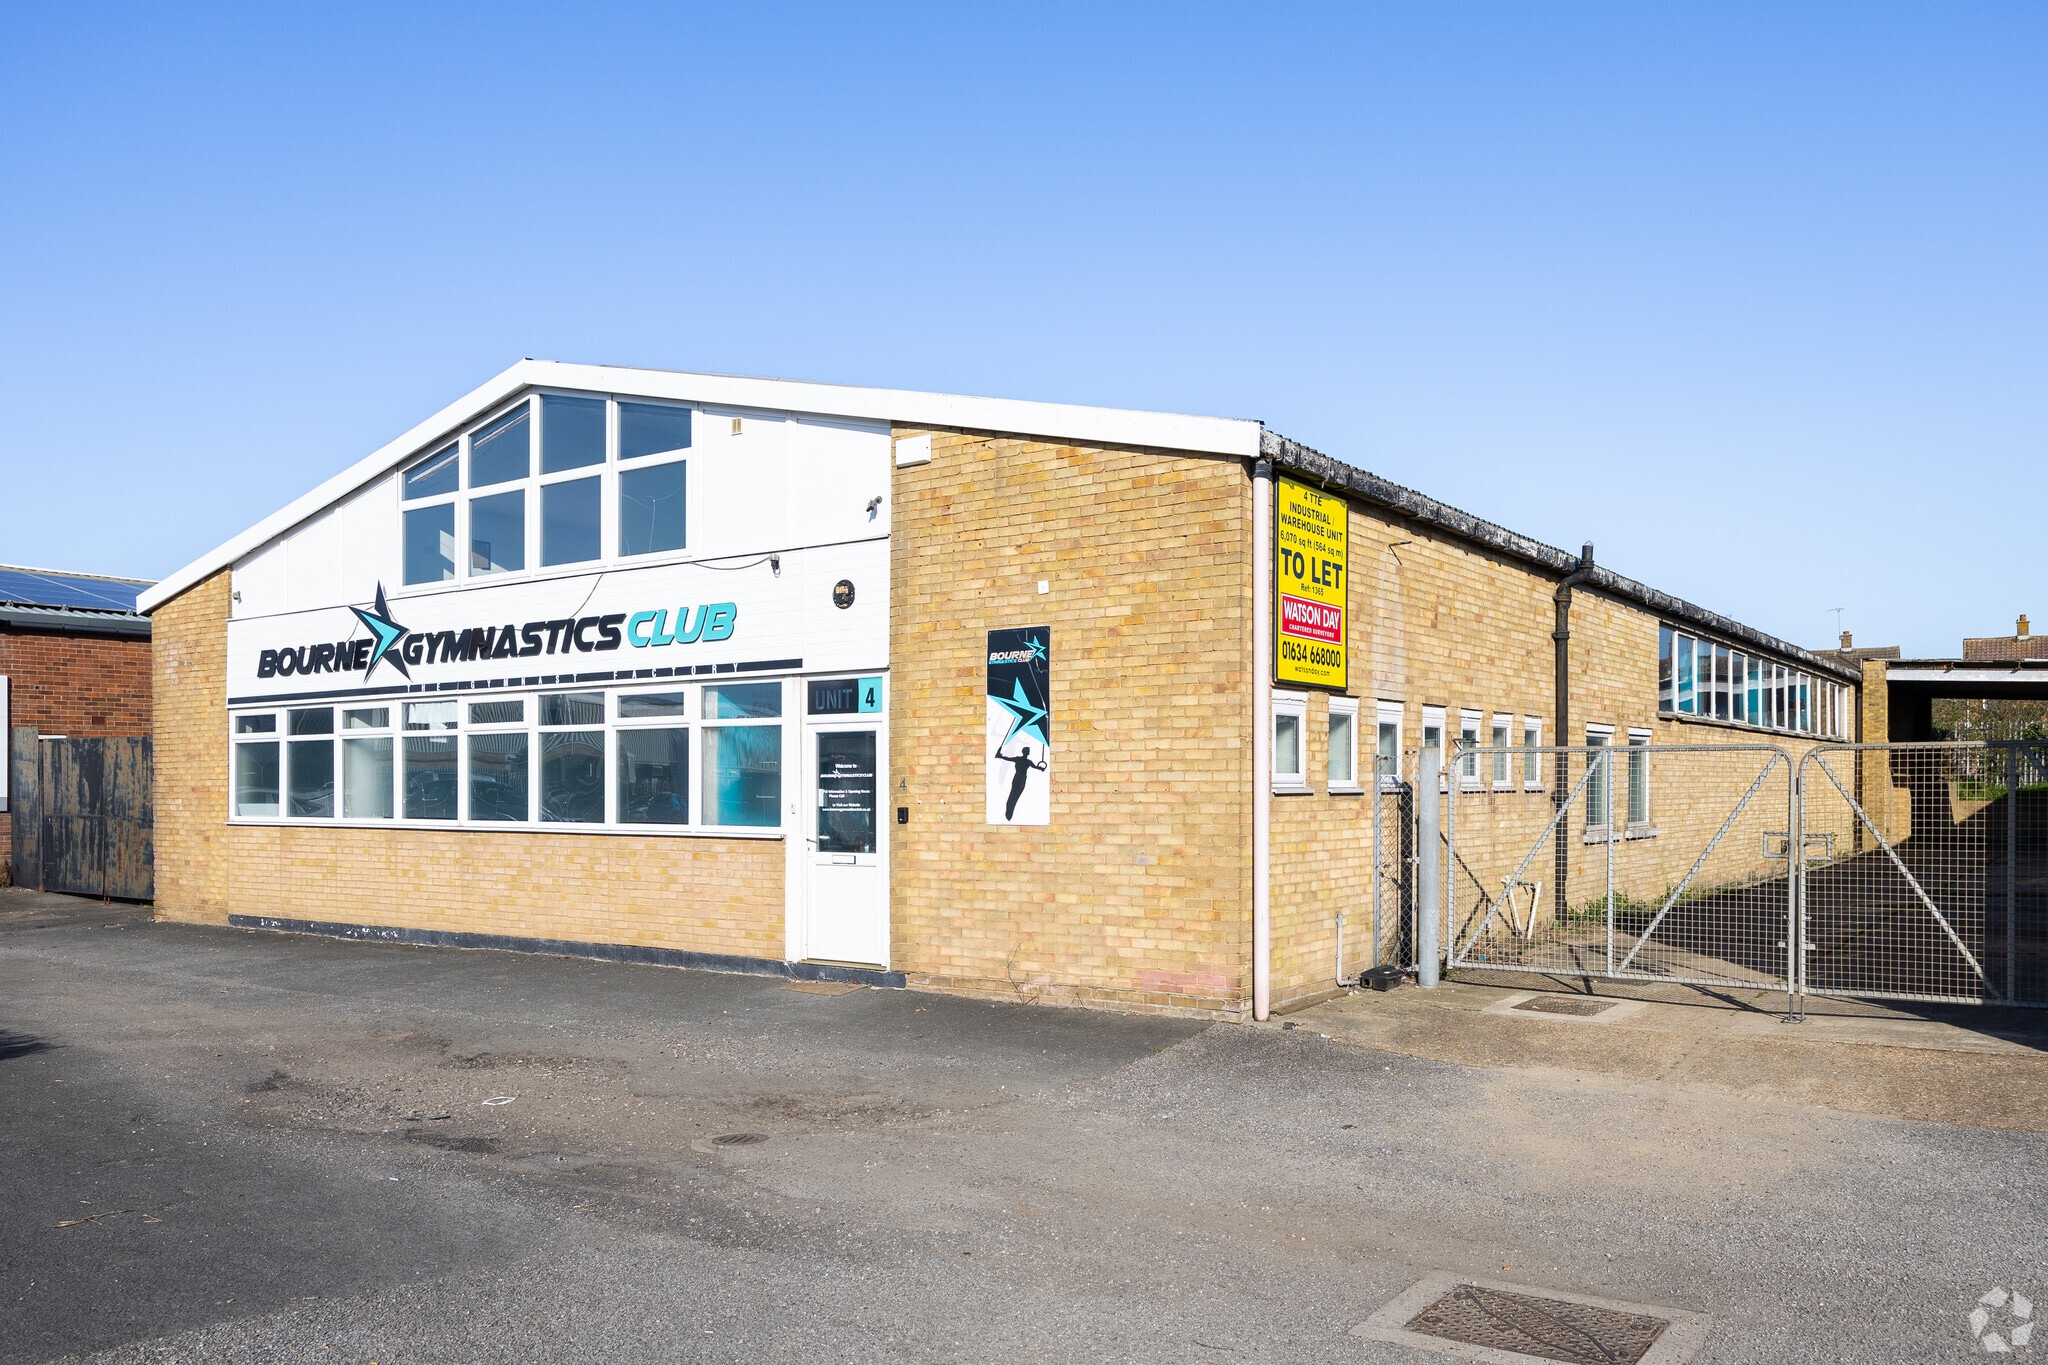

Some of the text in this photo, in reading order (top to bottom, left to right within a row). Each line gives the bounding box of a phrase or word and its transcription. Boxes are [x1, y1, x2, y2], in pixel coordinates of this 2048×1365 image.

[1304, 491, 1322, 506] 4 TTE
[1290, 501, 1331, 525] INDUSTRIAL
[1281, 512, 1343, 542] WAREHOUSE UNIT
[1280, 530, 1343, 561] 6,070 sq ft (564 sq m)
[1281, 547, 1343, 589] TO LET
[1301, 583, 1324, 596] Ref: 1365
[1284, 600, 1340, 630] WATSON DAY
[257, 602, 738, 678] BOURNE GYMNASTICS CLUB
[1289, 623, 1335, 638] CHARTERED SURVEYORS
[990, 650, 1034, 660] BOURNE
[1282, 640, 1341, 668] 01634 668000
[406, 662, 739, 693] THE GYMNAST FACTORY
[1295, 665, 1331, 677] watsonday.com
[815, 687, 876, 711] UNIT 4
[900, 777, 907, 790] 4
